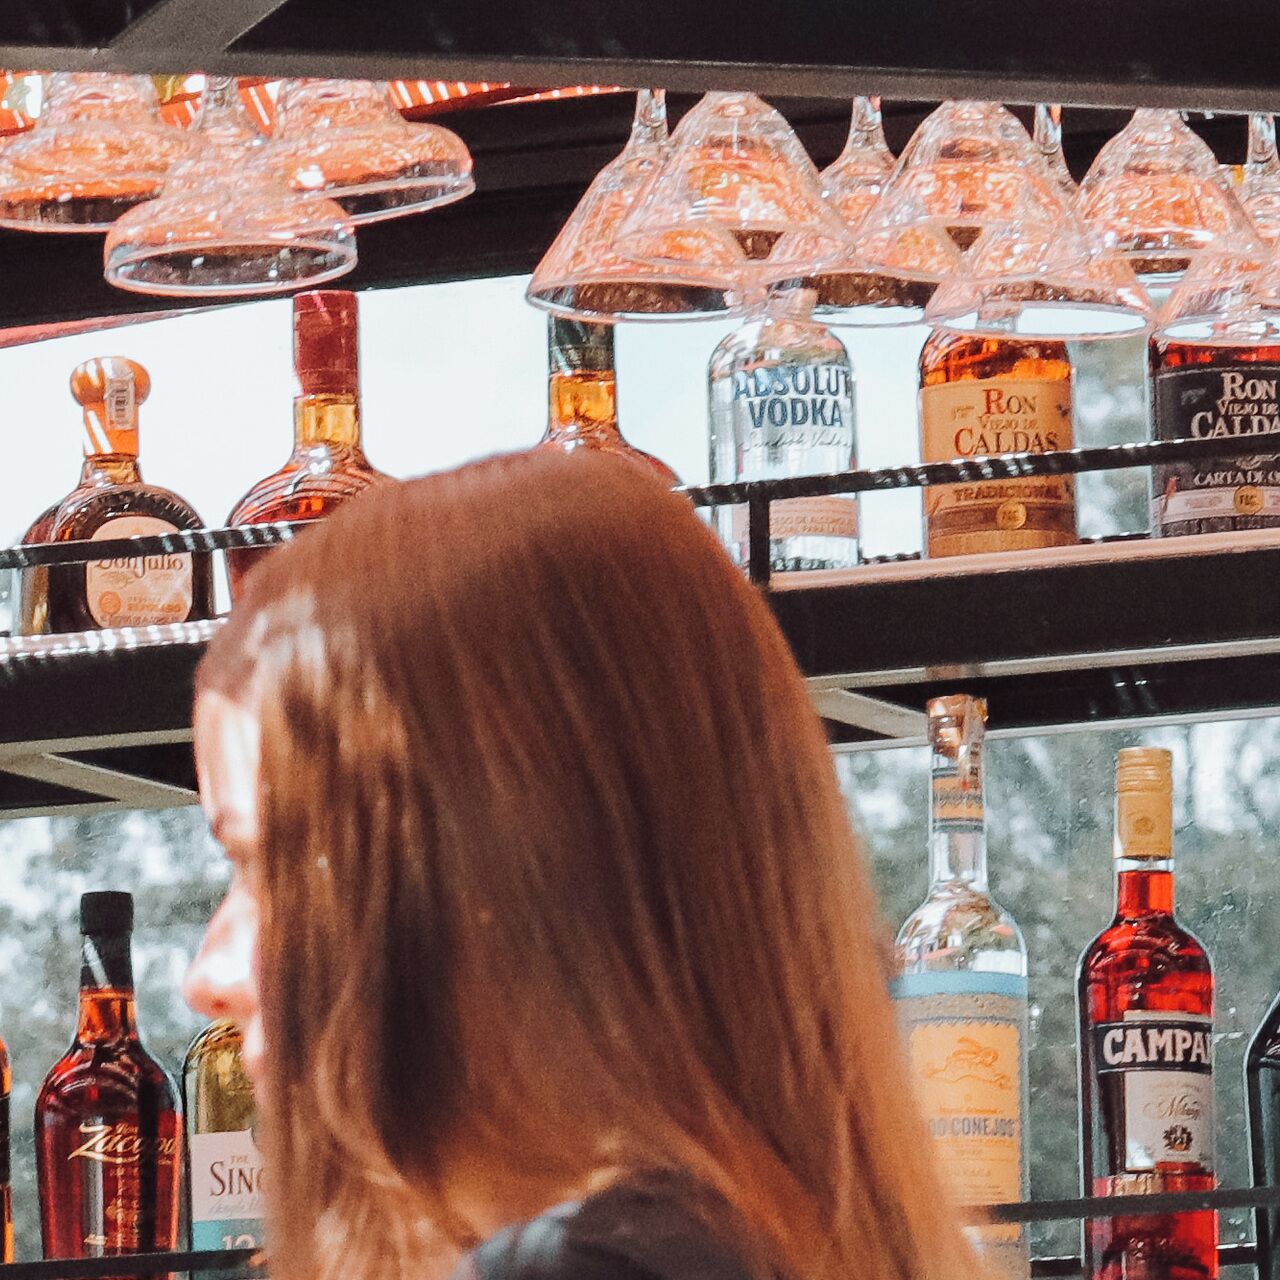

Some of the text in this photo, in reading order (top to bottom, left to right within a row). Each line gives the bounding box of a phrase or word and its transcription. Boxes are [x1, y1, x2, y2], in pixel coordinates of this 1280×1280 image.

[735, 366, 852, 400] ABSOLUT
[748, 398, 843, 428] VODKA
[954, 428, 1059, 456] CALDAS
